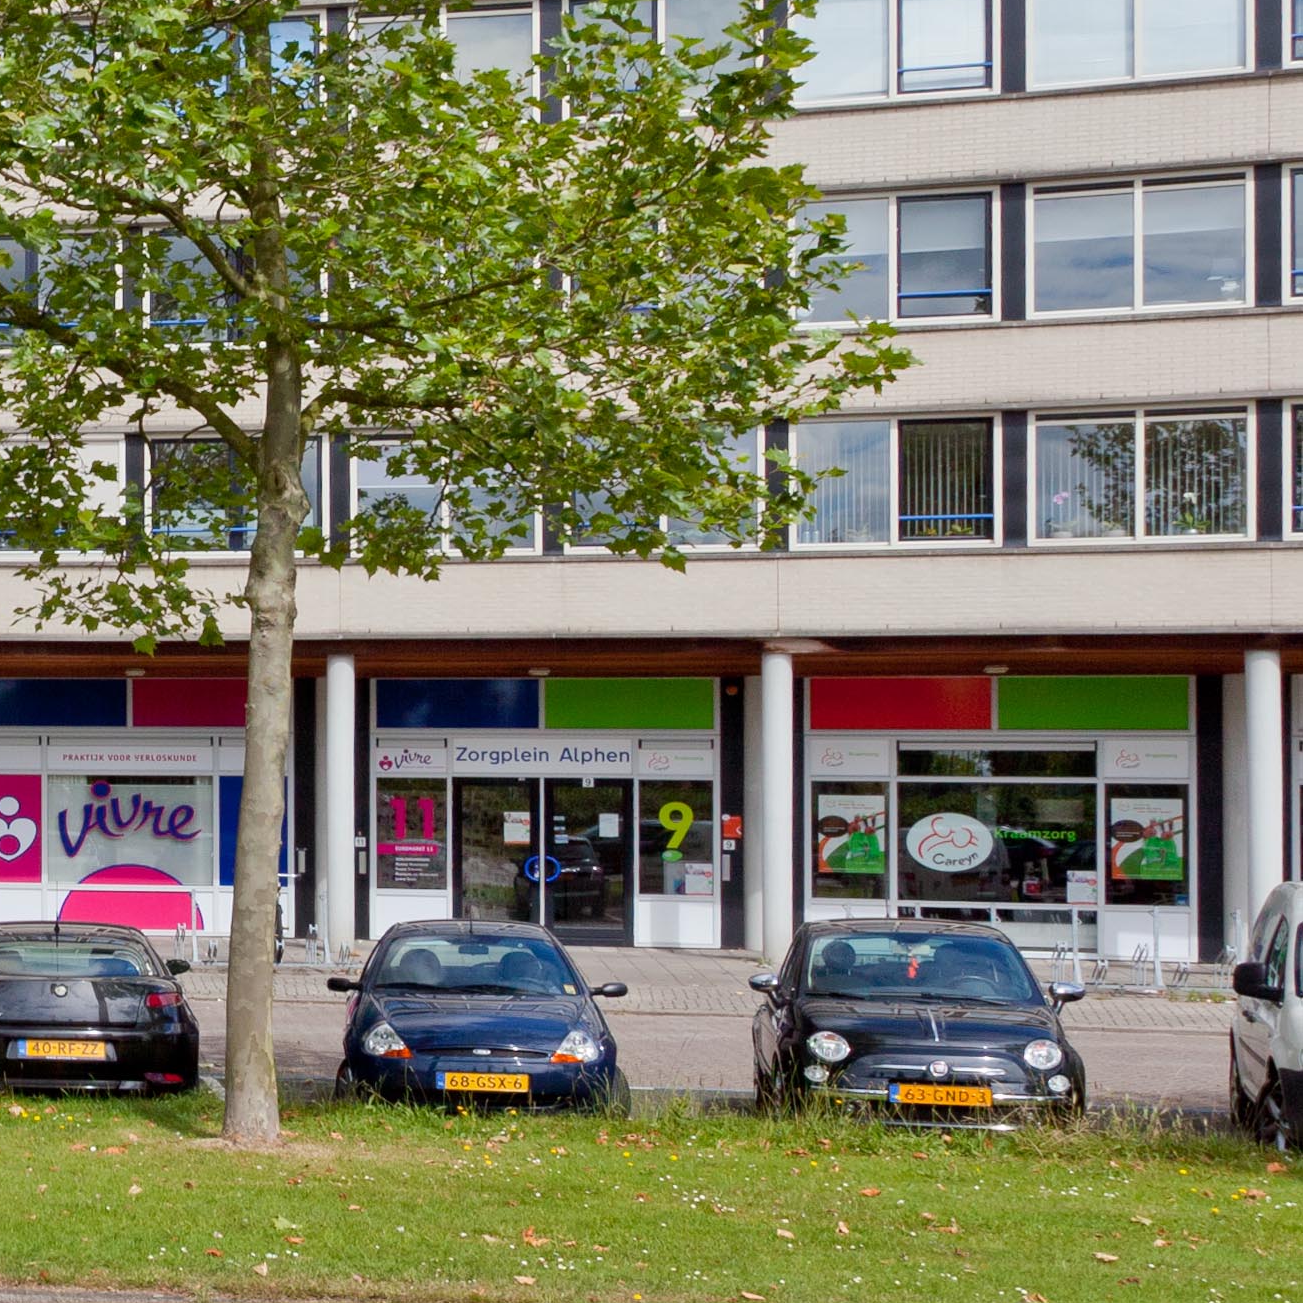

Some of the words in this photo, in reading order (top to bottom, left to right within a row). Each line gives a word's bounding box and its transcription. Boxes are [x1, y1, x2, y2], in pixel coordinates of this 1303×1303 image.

[62, 753, 105, 762] PRAKTIJK
[108, 753, 132, 762] VOOR
[134, 754, 198, 763] VERLOSKUNDE
[455, 746, 550, 765] Zorgplein
[559, 747, 631, 766] Alphen
[584, 778, 592, 787] 9
[390, 796, 435, 840] 11
[658, 801, 694, 849] 9
[994, 826, 1077, 842] Kraamzorg
[724, 840, 732, 849] 9
[932, 852, 979, 867] Careyn
[32, 1041, 99, 1056] 40-RF-ZZ
[449, 1075, 523, 1090] 68-GSX-6
[904, 1087, 987, 1103] 63-GND-3
